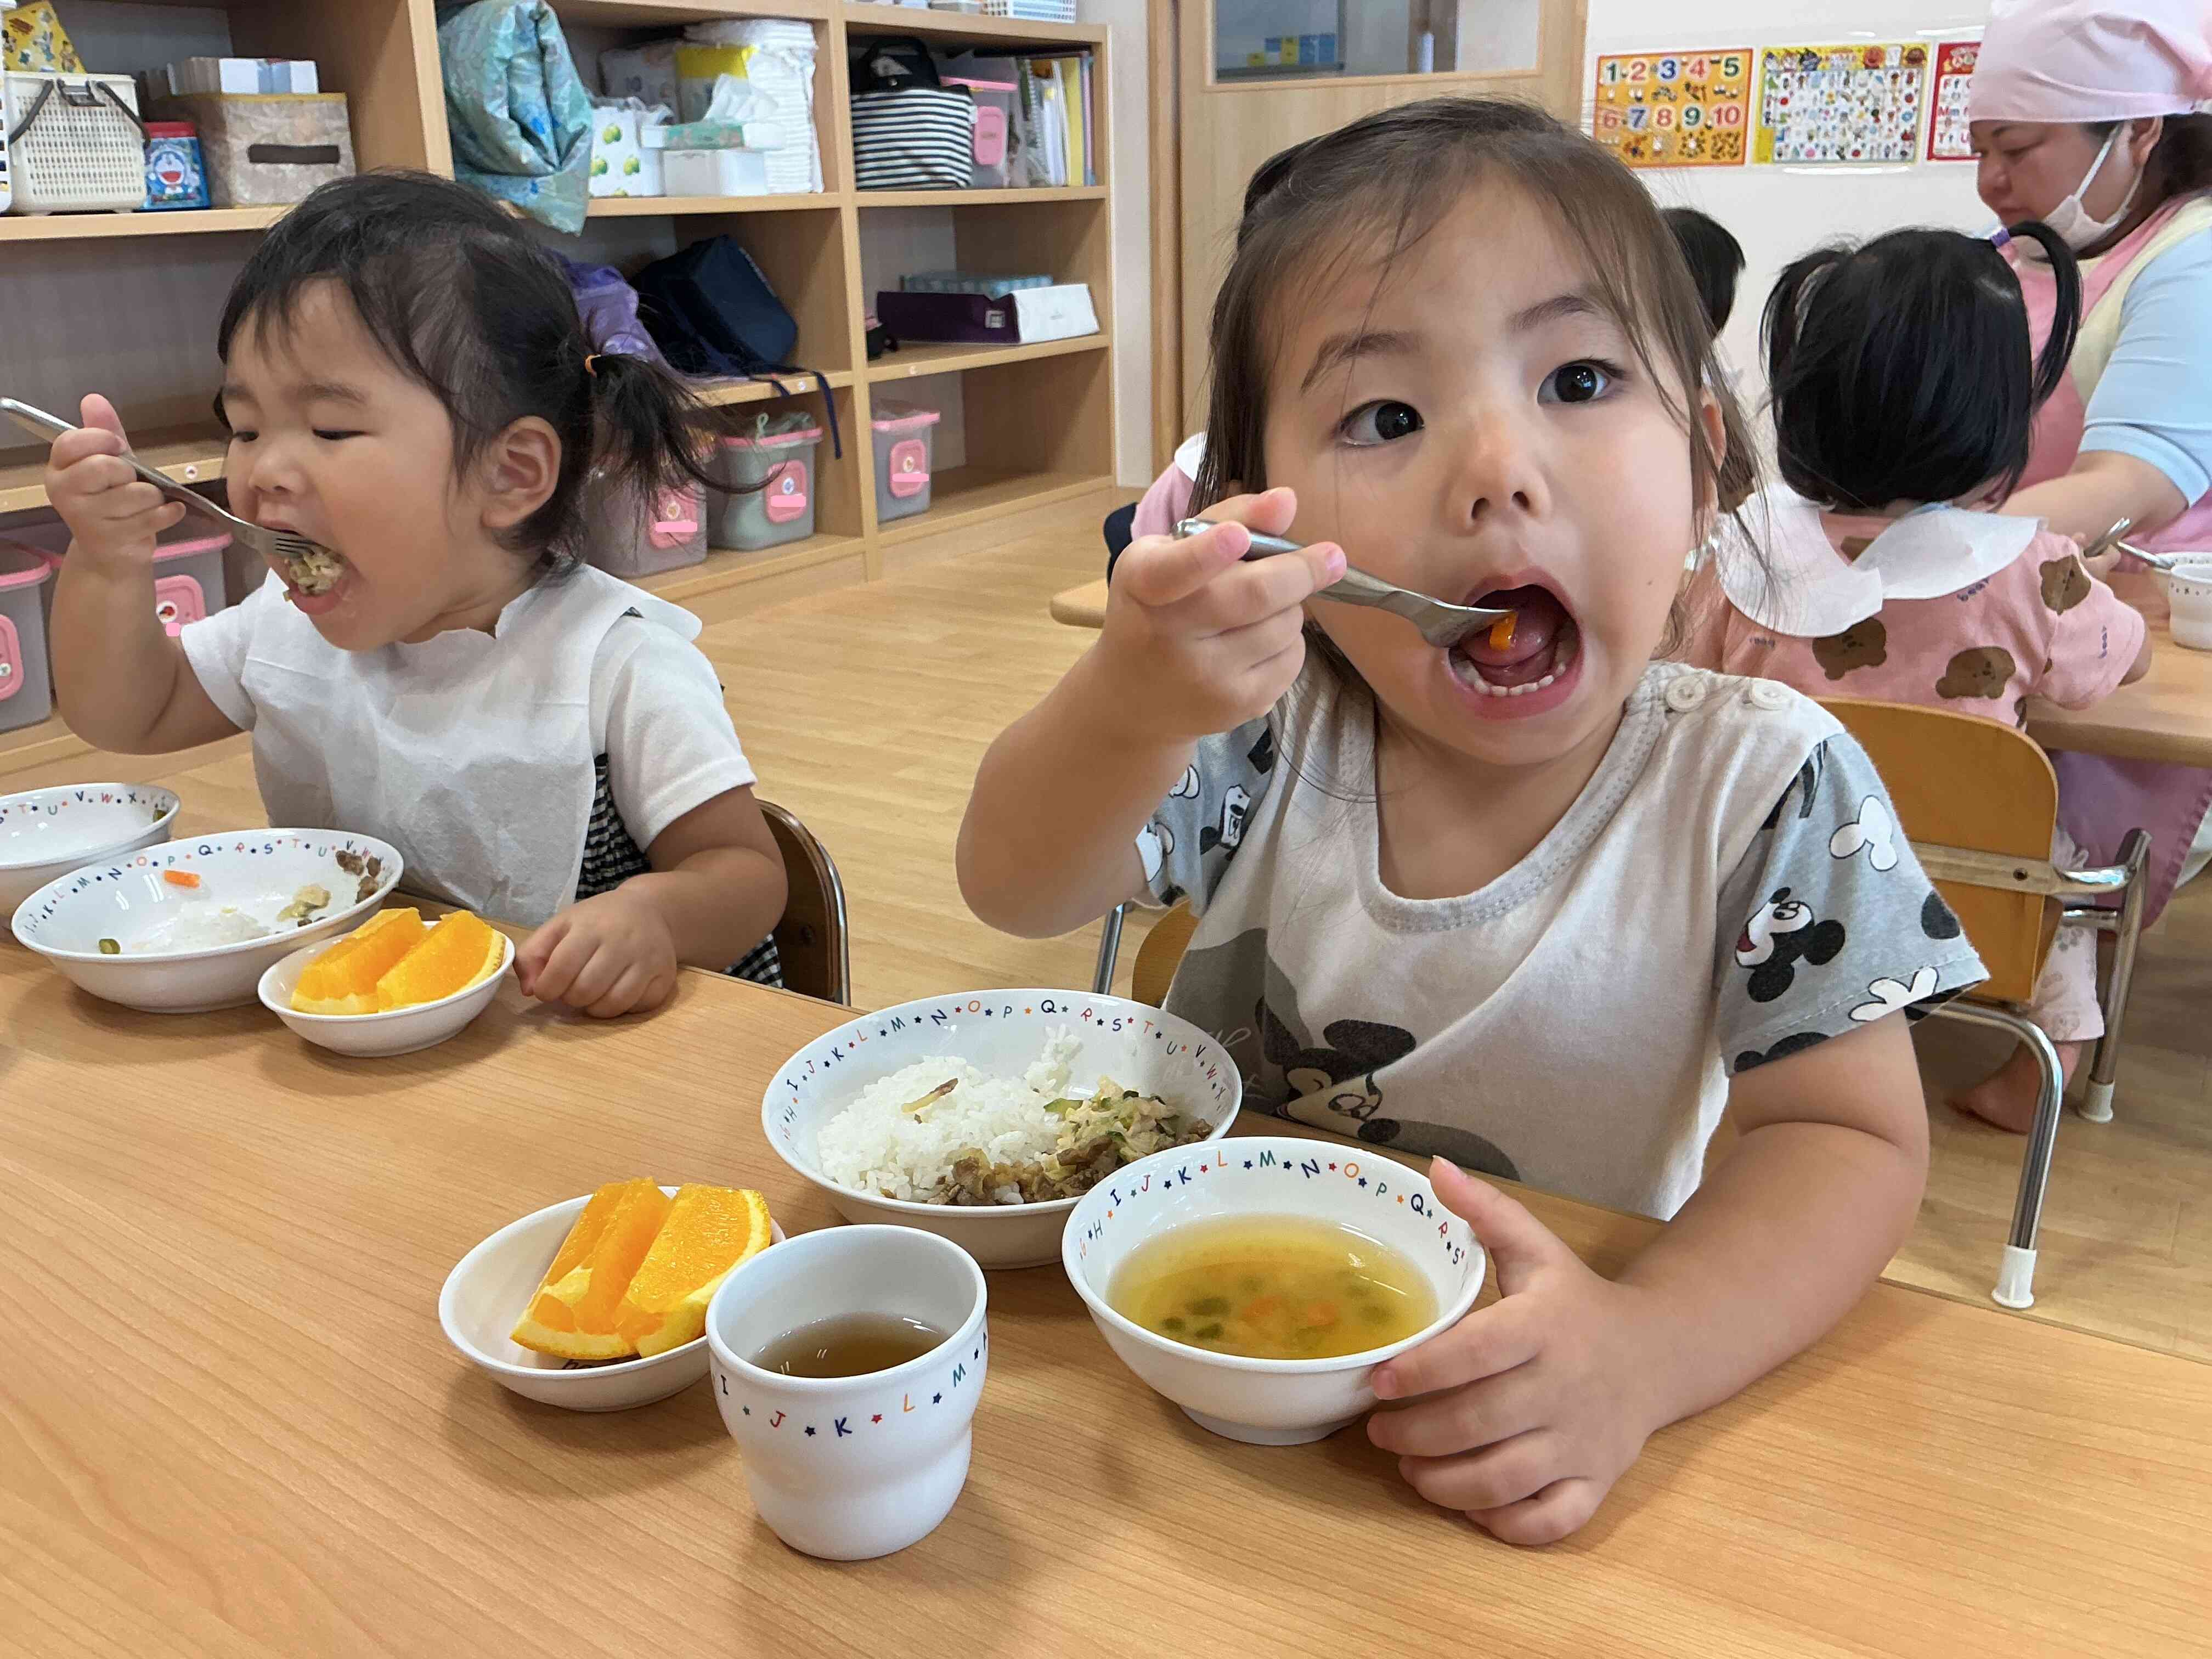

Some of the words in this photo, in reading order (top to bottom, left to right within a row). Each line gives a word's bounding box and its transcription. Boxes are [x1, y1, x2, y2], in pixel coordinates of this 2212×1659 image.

[1606, 63, 1617, 81] 1
[1631, 62, 1646, 81] 2
[1661, 59, 1677, 79] 3
[1689, 59, 1706, 78] 4
[1724, 57, 1740, 77] 5
[1604, 112, 1617, 127] 6
[1632, 109, 1646, 128] 7
[1657, 108, 1672, 127] 8
[1684, 106, 1701, 126] 9
[1714, 105, 1741, 125] 10
[48, 805, 58, 816] U
[76, 791, 84, 802] V
[101, 792, 113, 804] W
[128, 792, 137, 803] X
[43, 905, 53, 915] K
[77, 877, 90, 888] M
[108, 868, 122, 881] N
[136, 856, 147, 867] O
[168, 855, 176, 866] P
[199, 845, 214, 856] Q
[235, 842, 245, 853] R
[264, 843, 273, 855] S
[292, 838, 301, 848] T
[318, 847, 327, 857] U
[347, 840, 354, 850] V
[968, 1000, 980, 1012] O
[1003, 1006, 1012, 1018] P
[1041, 1000, 1057, 1013] Q
[931, 1009, 947, 1025] N
[1081, 1008, 1092, 1022] R
[891, 1017, 906, 1032] M
[1112, 1018, 1122, 1031] S
[1144, 1020, 1154, 1033] T
[857, 1029, 867, 1041] L
[831, 1047, 844, 1061] K
[1167, 1041, 1177, 1054] U
[1195, 1045, 1206, 1058] V
[806, 1060, 815, 1074] J
[1206, 1063, 1217, 1080] W
[787, 1079, 798, 1091] I
[1215, 1087, 1226, 1101] X
[786, 1106, 797, 1122] H
[1093, 1218, 1103, 1240] H
[1110, 1188, 1121, 1206] I
[1142, 1175, 1151, 1192] J
[1178, 1166, 1192, 1184] K
[1218, 1150, 1228, 1167] L
[1260, 1150, 1277, 1168] M
[1301, 1159, 1321, 1178] N
[1344, 1163, 1359, 1178] O
[1376, 1182, 1387, 1197] P
[1410, 1193, 1425, 1216] Q
[1438, 1221, 1448, 1238] R
[1453, 1248, 1461, 1265] S
[720, 1374, 729, 1396] I
[770, 1410, 786, 1427] J
[834, 1417, 853, 1437] K
[904, 1393, 915, 1413] L
[952, 1363, 967, 1387] M
